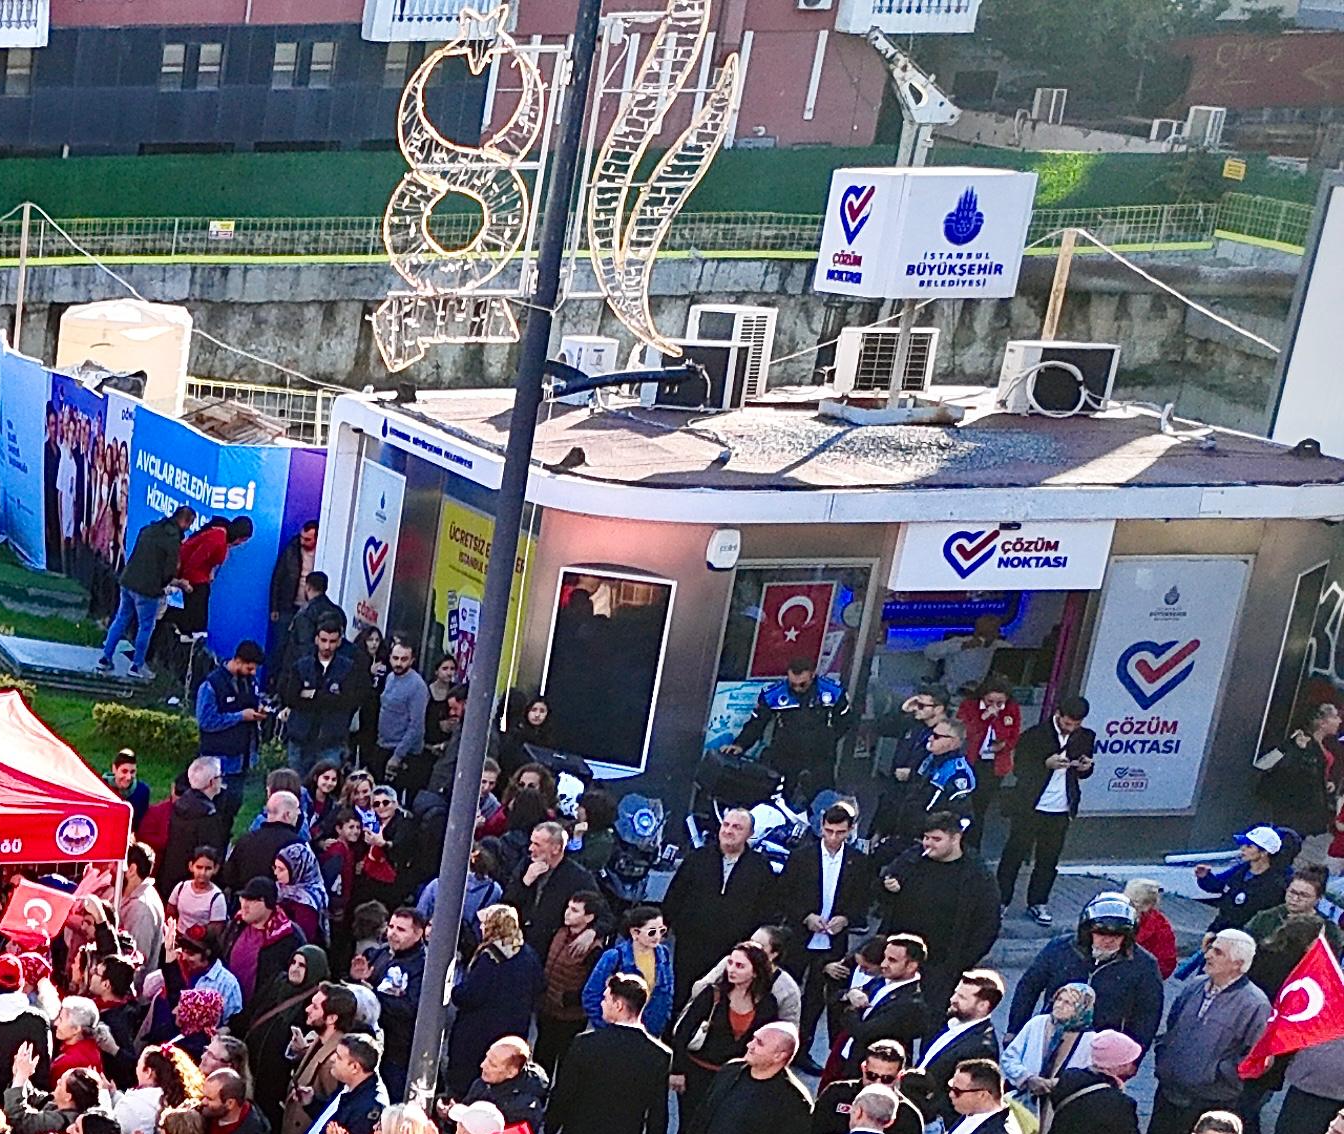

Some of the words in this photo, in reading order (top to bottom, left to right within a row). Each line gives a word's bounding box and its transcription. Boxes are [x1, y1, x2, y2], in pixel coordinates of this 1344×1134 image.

[923, 251, 990, 261] İSTANBUL
[906, 261, 1003, 277] BÜYÜKŞEHİR
[919, 279, 987, 288] BELEDİYESİ
[135, 449, 173, 487] AVCILAR
[174, 467, 256, 511] BELEDİYESİ
[1001, 538, 1060, 555] ÇÖZÜM
[997, 556, 1068, 569] NOKTASI
[1106, 716, 1179, 737] ÇÖZÜM
[1093, 740, 1181, 754] NOKTASI
